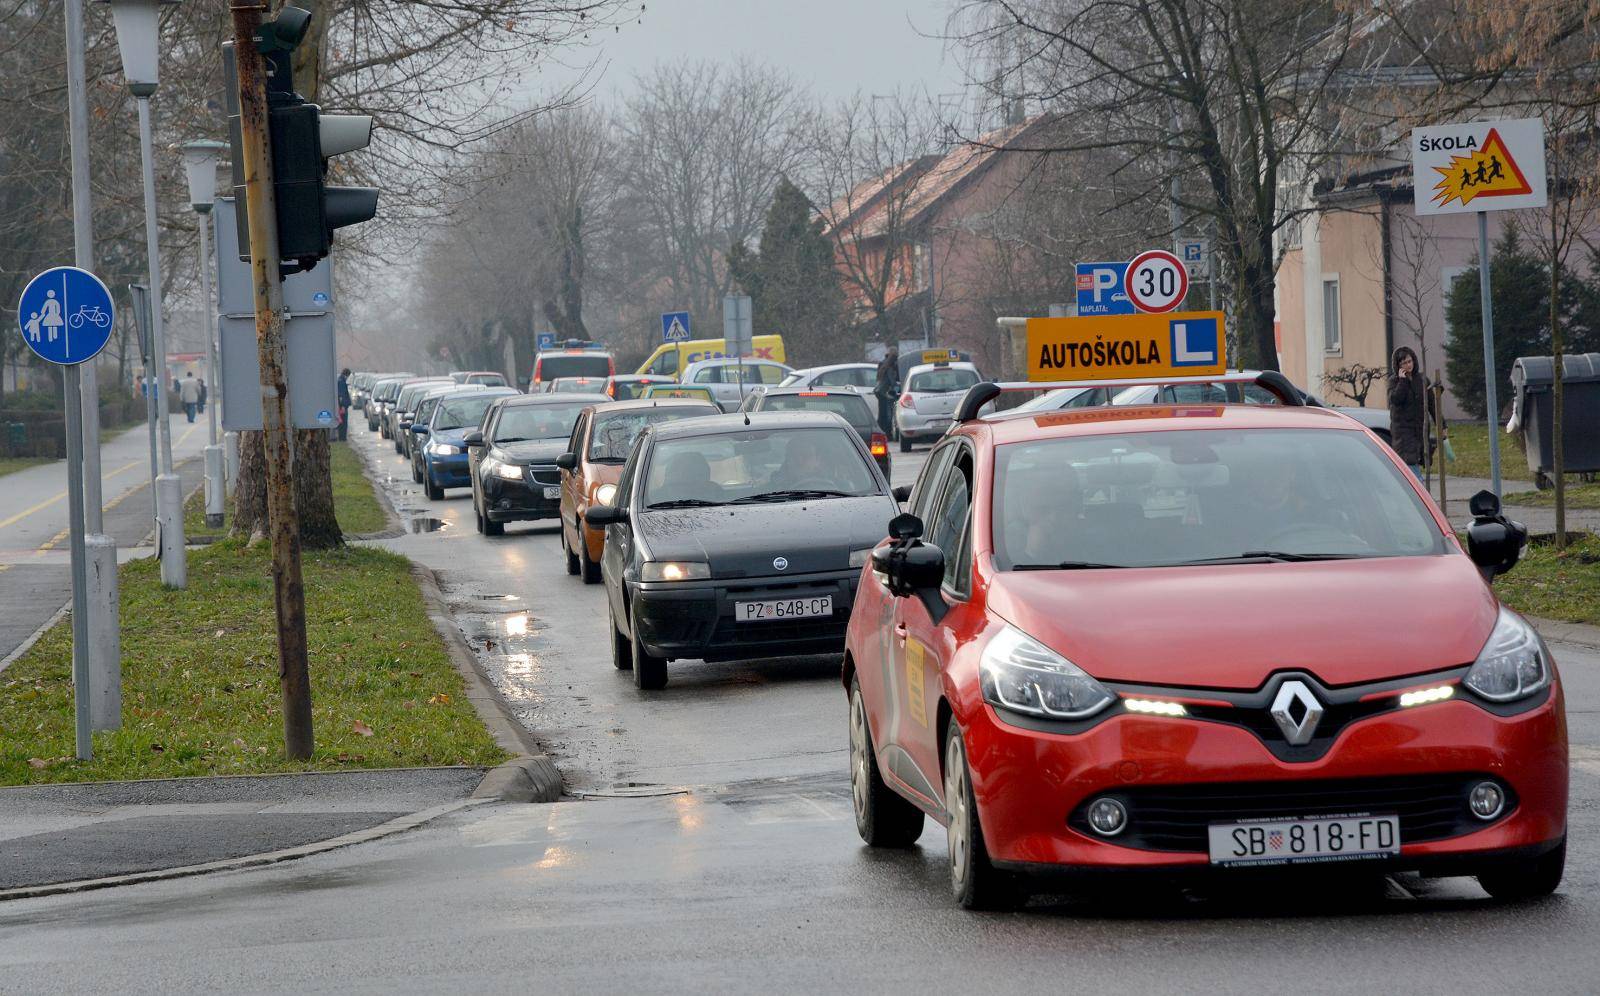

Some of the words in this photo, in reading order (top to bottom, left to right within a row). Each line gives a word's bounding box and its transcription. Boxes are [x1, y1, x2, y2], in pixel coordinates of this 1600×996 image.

[1419, 135, 1477, 152] ŠKOLA
[1093, 268, 1118, 302] P
[1139, 267, 1175, 297] 30
[1039, 335, 1161, 369] AUTOŠKOLA
[1174, 323, 1213, 362] L
[746, 602, 765, 619] PZ
[775, 598, 830, 618] 648-CP
[1231, 827, 1266, 857] SB
[1289, 819, 1394, 854] 818-FD
